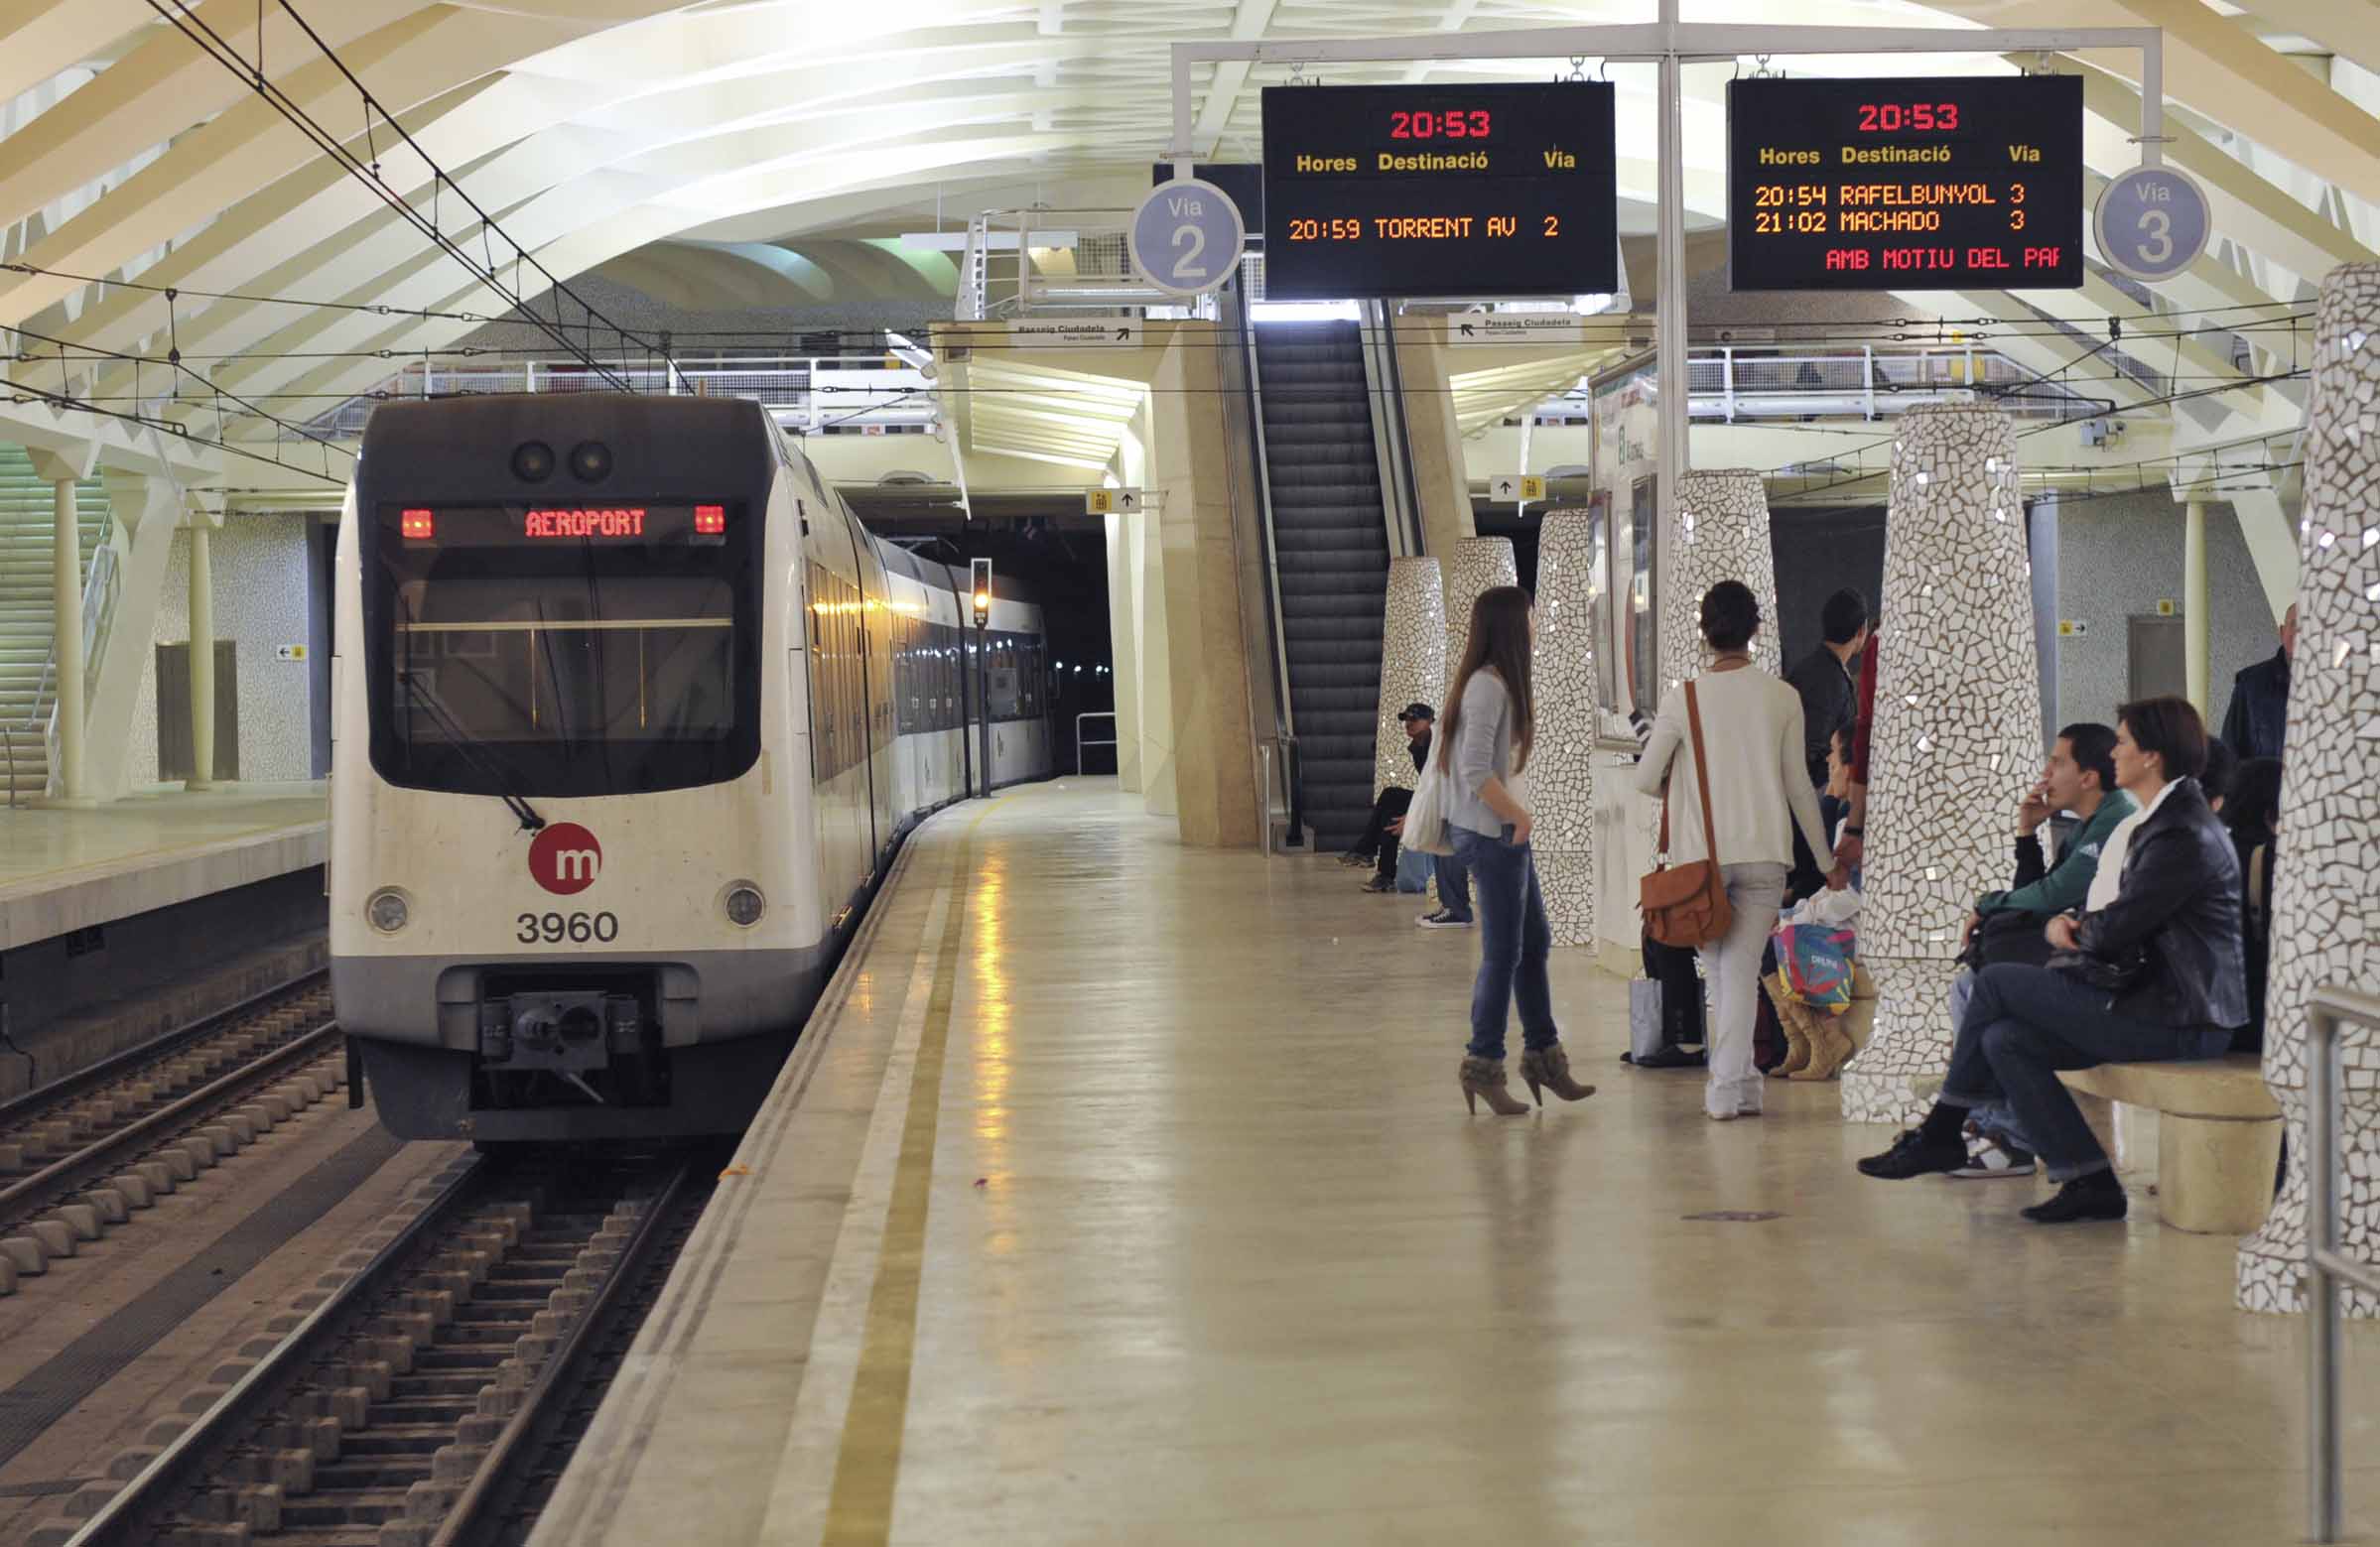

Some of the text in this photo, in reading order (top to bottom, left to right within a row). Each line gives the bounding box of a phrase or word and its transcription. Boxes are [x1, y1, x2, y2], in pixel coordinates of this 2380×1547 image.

[1390, 110, 1491, 139] 20:53
[1858, 103, 1958, 132] 20:53
[1296, 151, 1576, 172] Hores Destinació Via
[1760, 145, 2041, 165] Hores Destinació Via
[1755, 183, 2026, 206] 20:54 RAFELBUNYOL 3
[2135, 182, 2171, 202] Via
[1167, 197, 1204, 217] Via
[1289, 215, 1560, 240] 20:59 TORRENT AV 2
[1755, 209, 2026, 233] 21:02 MACHADO 3
[2137, 208, 2174, 264] 3
[1172, 224, 1208, 279] 2
[1825, 248, 1870, 271] AMB
[1883, 247, 1954, 270] MOTIU
[1967, 247, 2010, 269] DEL
[524, 507, 646, 537] AEROPORT
[556, 848, 599, 880] m
[516, 911, 618, 944] 3960
